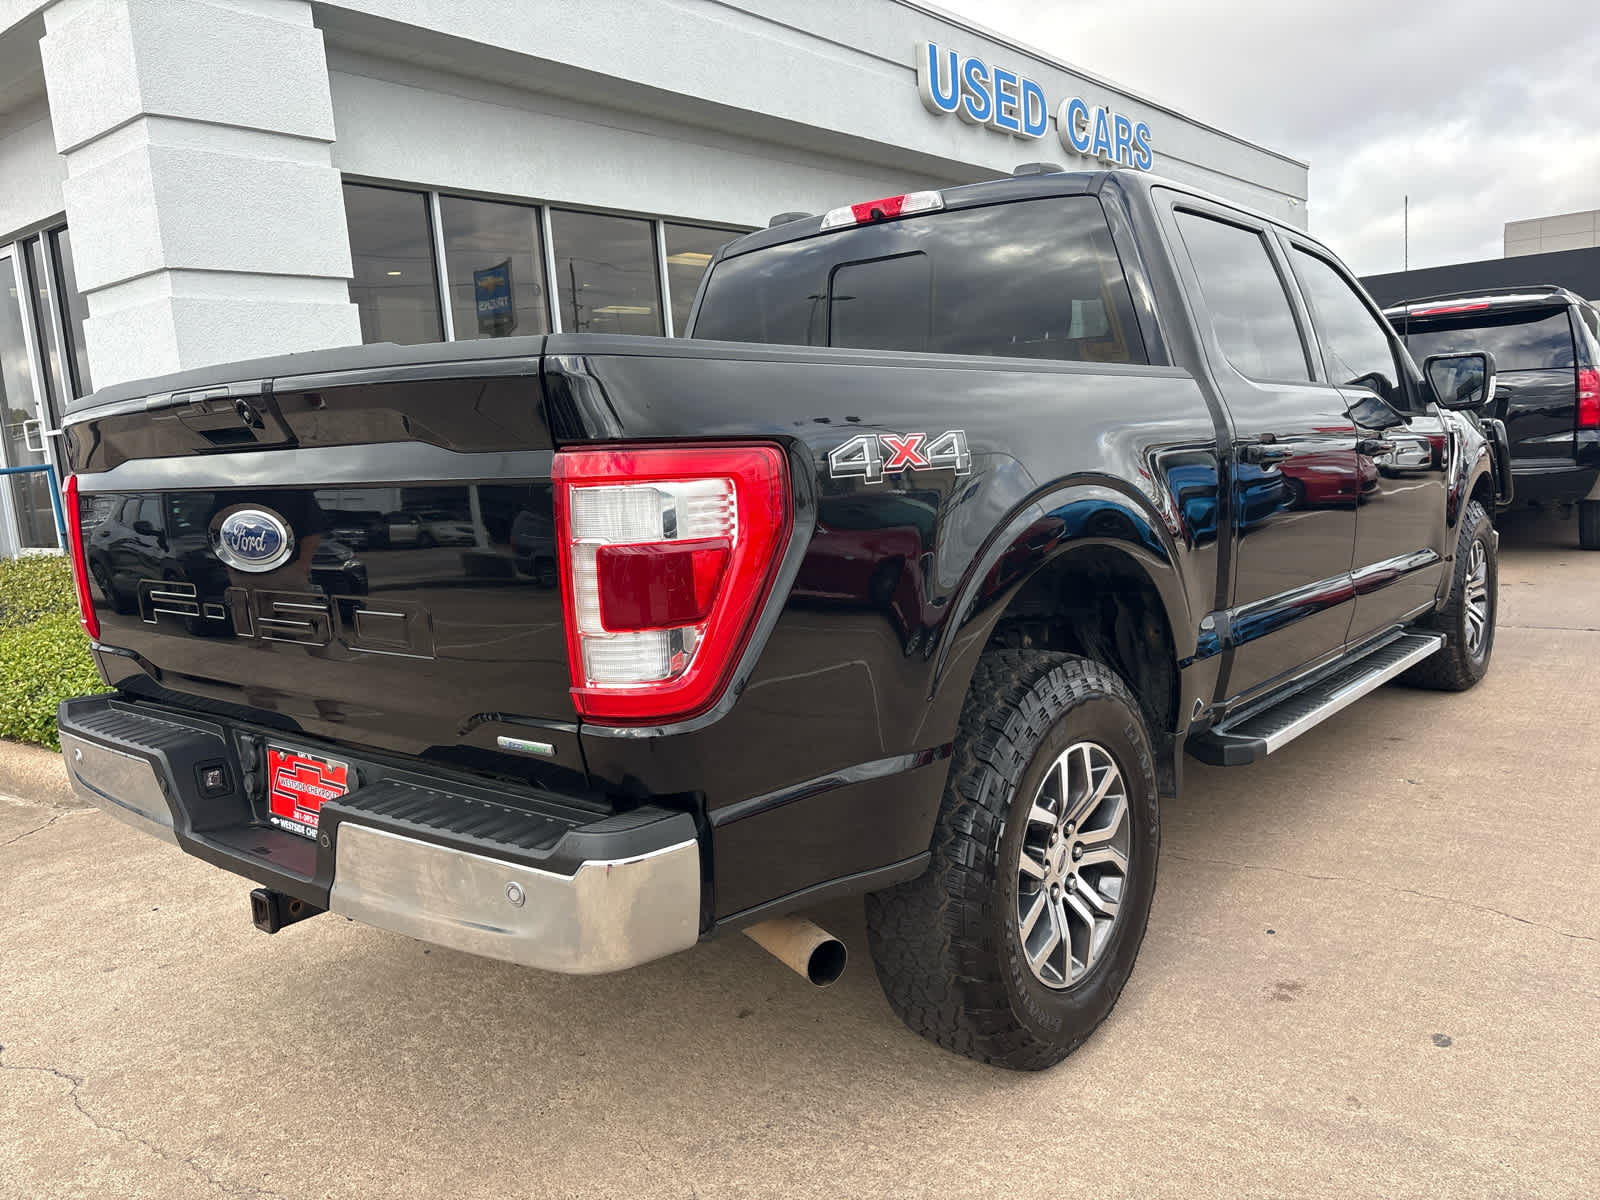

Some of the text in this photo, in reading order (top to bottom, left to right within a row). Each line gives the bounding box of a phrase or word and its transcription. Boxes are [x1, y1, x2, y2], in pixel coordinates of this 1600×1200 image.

[925, 40, 1154, 172] USED CARS
[231, 521, 267, 552] Ford
[137, 578, 436, 661] F-150
[279, 777, 306, 791] WESTSIDE
[280, 818, 306, 834] WESTSIDE
